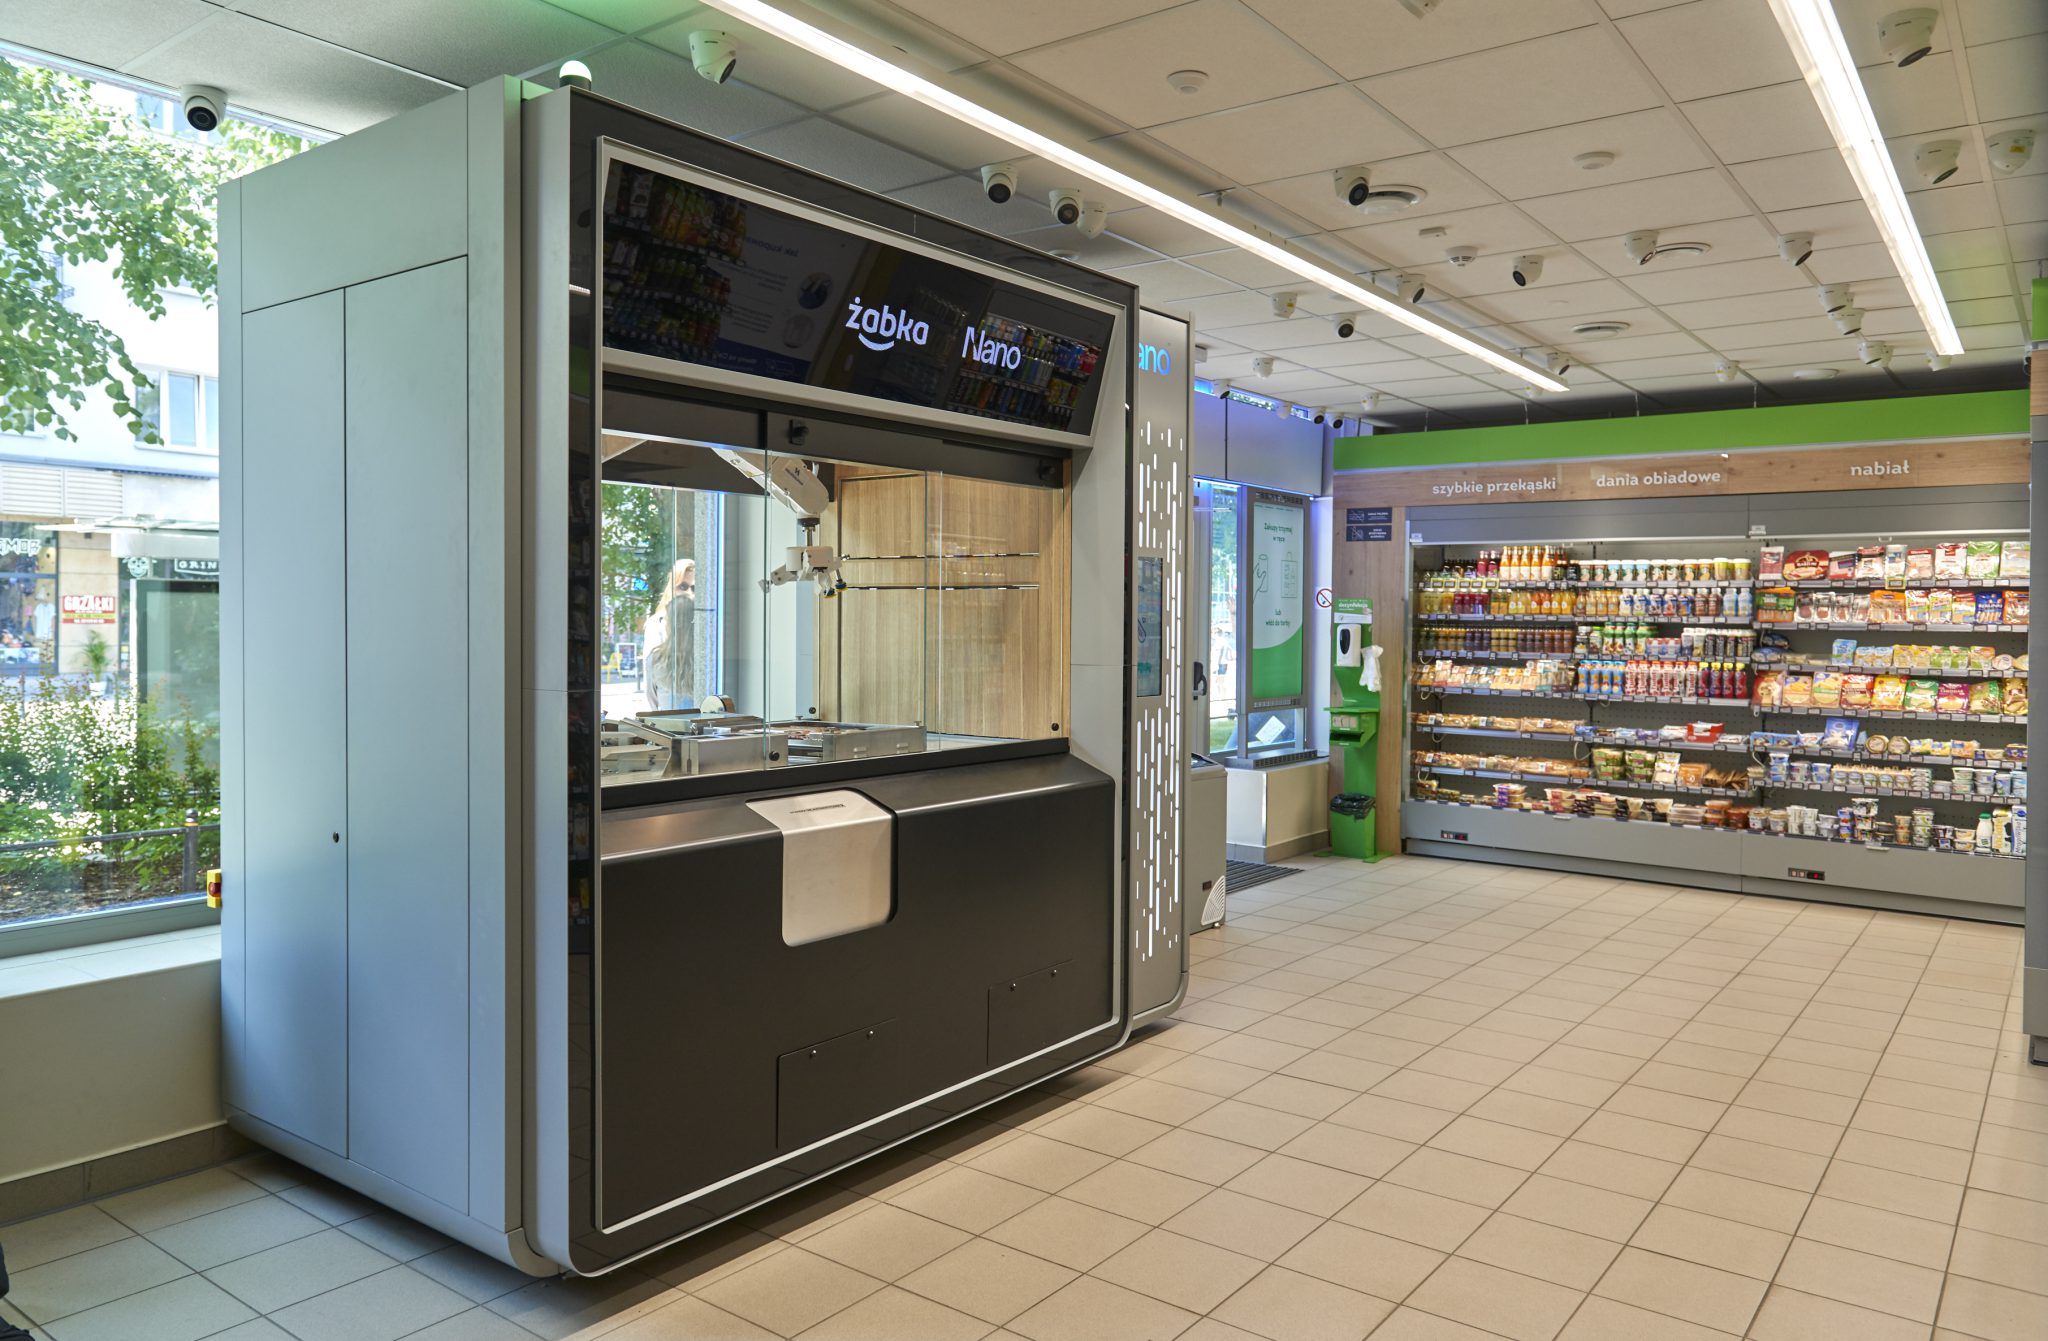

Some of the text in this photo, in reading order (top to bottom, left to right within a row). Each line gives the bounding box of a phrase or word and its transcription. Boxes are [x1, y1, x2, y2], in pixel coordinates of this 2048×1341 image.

[846, 297, 1021, 369] żabka Nano
[1850, 459, 1910, 476] nabiał
[1432, 477, 1556, 497] szybkie przekąski
[1596, 470, 1721, 487] dania obiadowe
